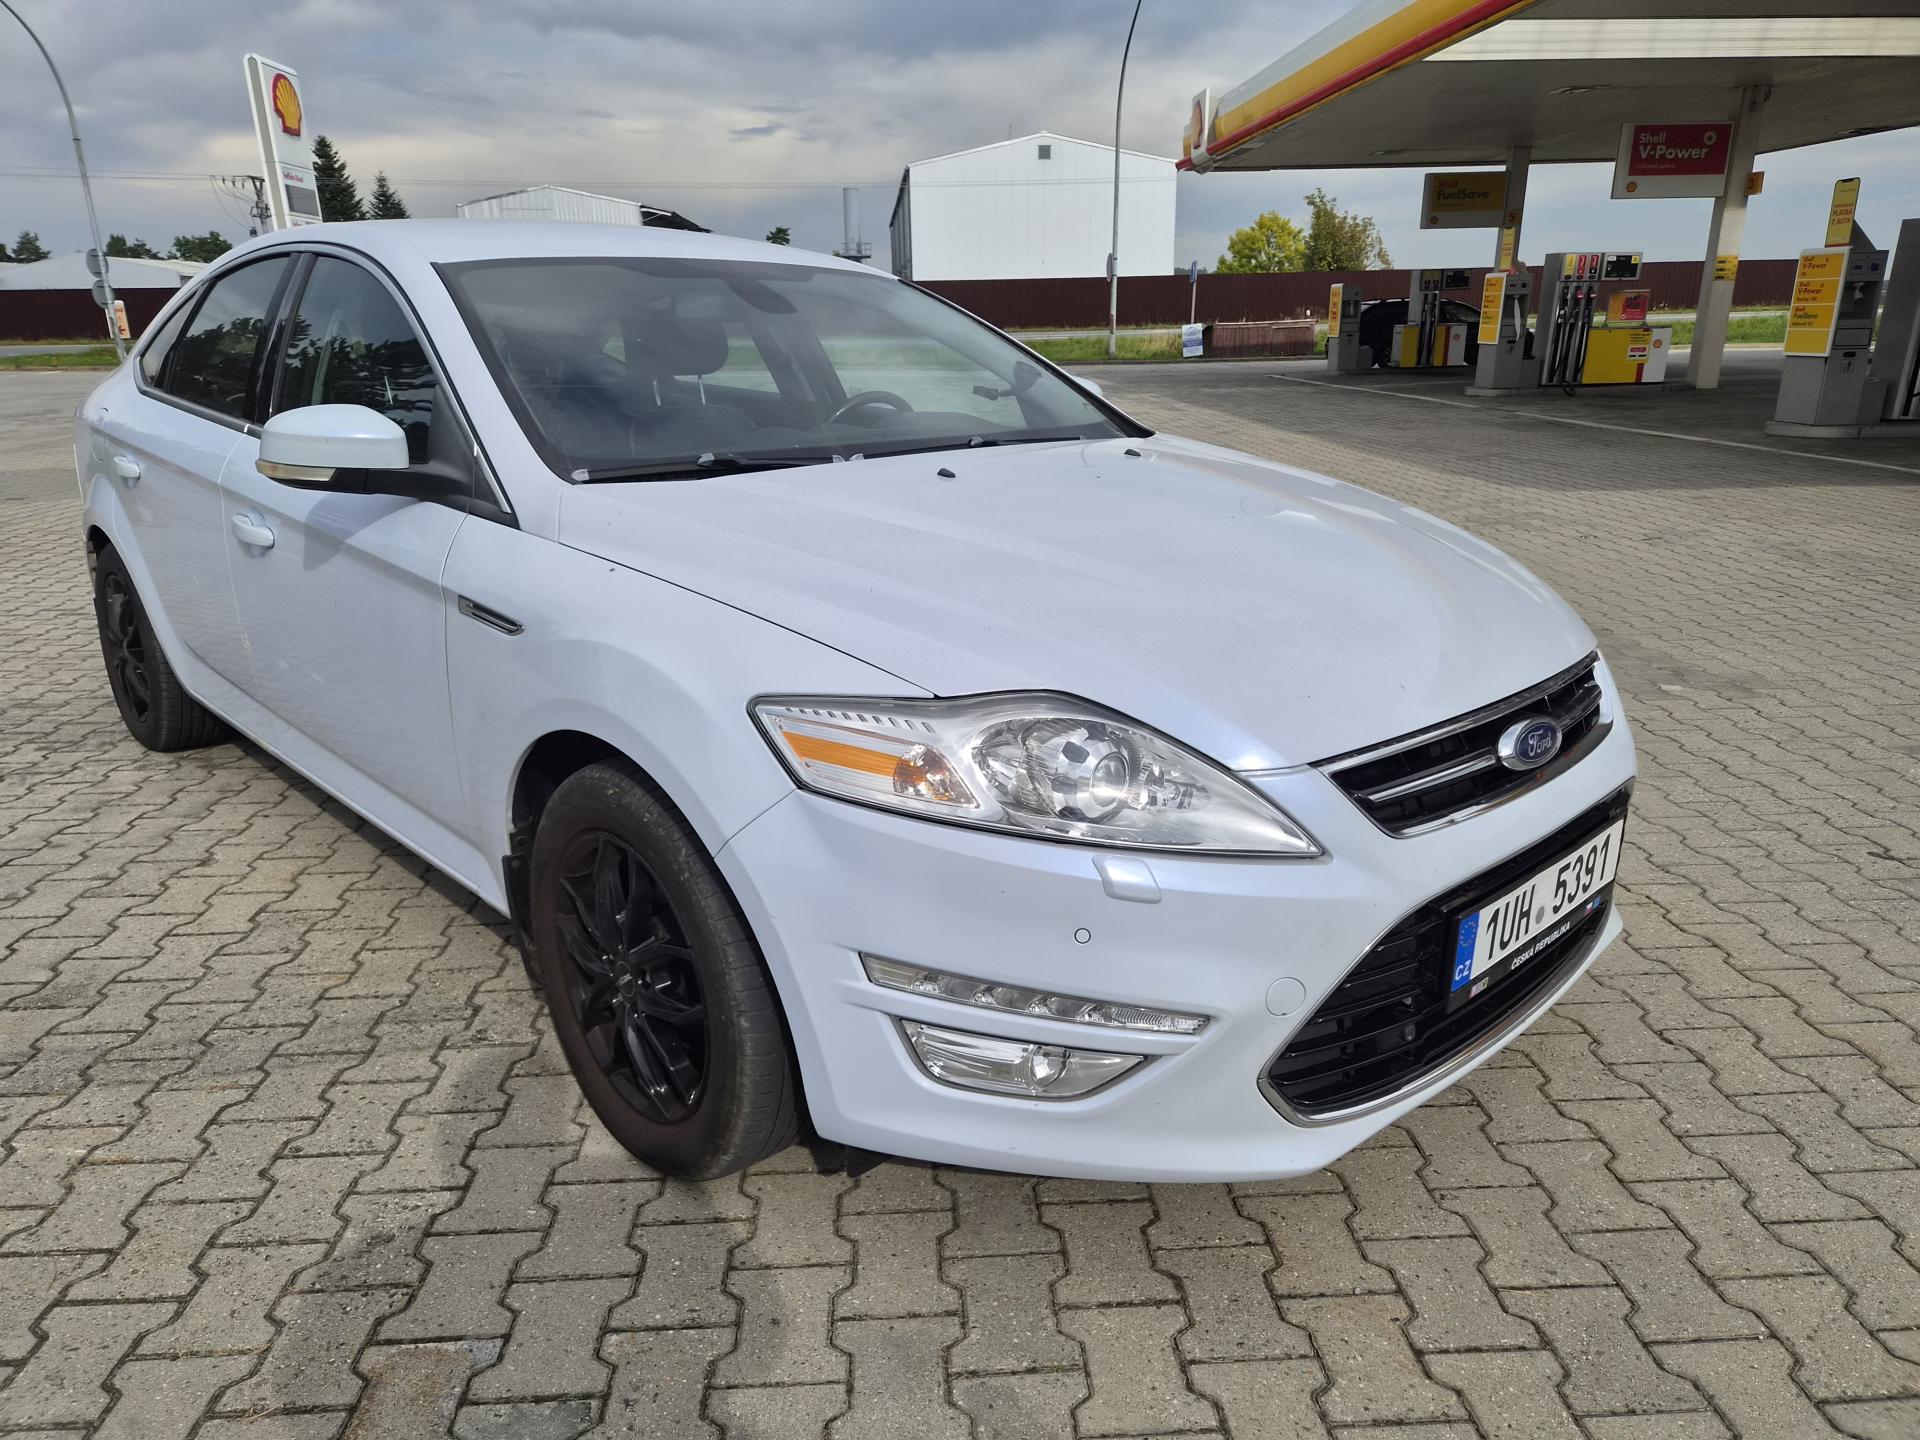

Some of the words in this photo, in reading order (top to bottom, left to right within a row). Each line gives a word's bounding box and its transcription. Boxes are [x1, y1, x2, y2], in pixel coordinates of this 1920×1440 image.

[1639, 132, 1666, 144] Shell
[1639, 145, 1709, 159] V-Power
[1438, 179, 1458, 188] Shell
[1437, 188, 1490, 200] FuelSave
[1802, 262, 1827, 270] V-Power
[1797, 287, 1822, 295] V-Power
[1528, 729, 1552, 757] Ford
[1485, 883, 1536, 961] 1UH
[1552, 832, 1612, 915] 5391
[1534, 921, 1570, 953] REPUBLIKA
[1455, 959, 1471, 981] CZ
